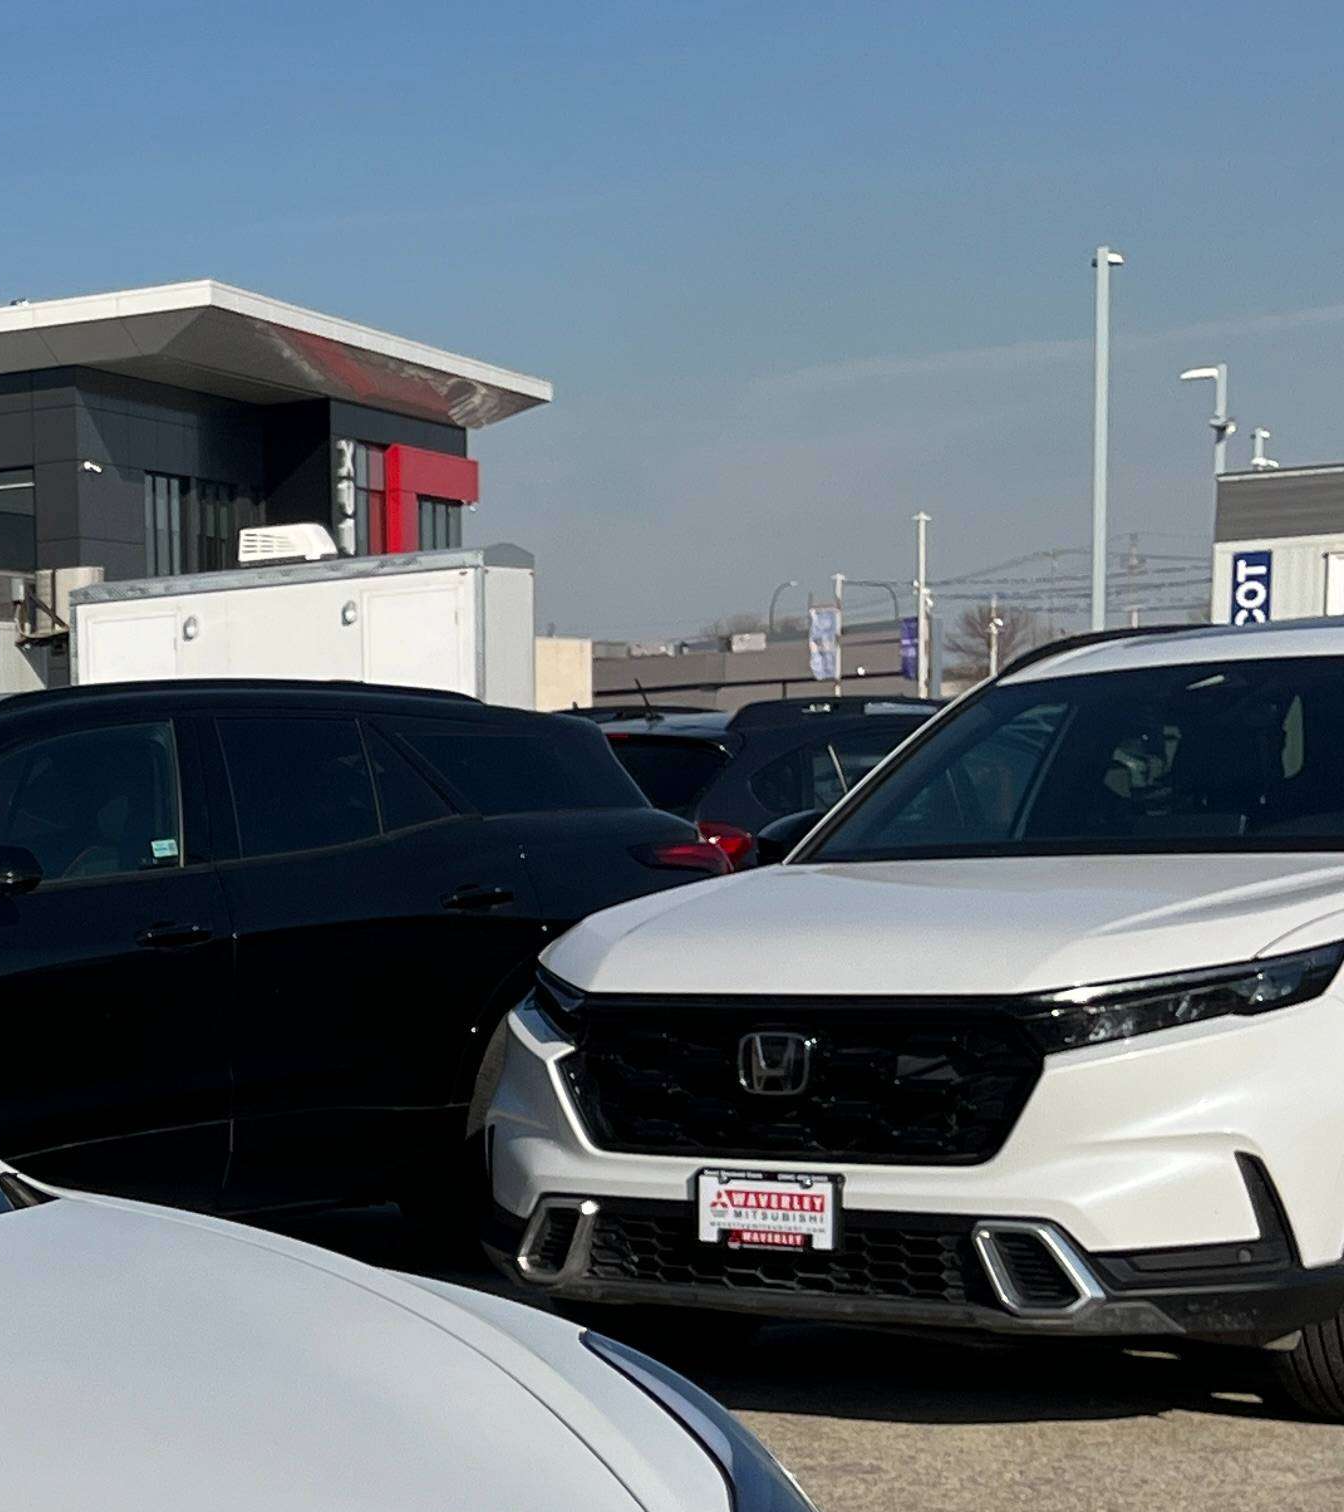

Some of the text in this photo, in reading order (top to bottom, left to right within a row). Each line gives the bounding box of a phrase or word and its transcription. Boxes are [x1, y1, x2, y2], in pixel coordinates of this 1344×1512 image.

[731, 1191, 824, 1212] WAVERLEY
[734, 1210, 824, 1223] MITSUBISHI
[742, 1230, 803, 1246] WAVERLEY
